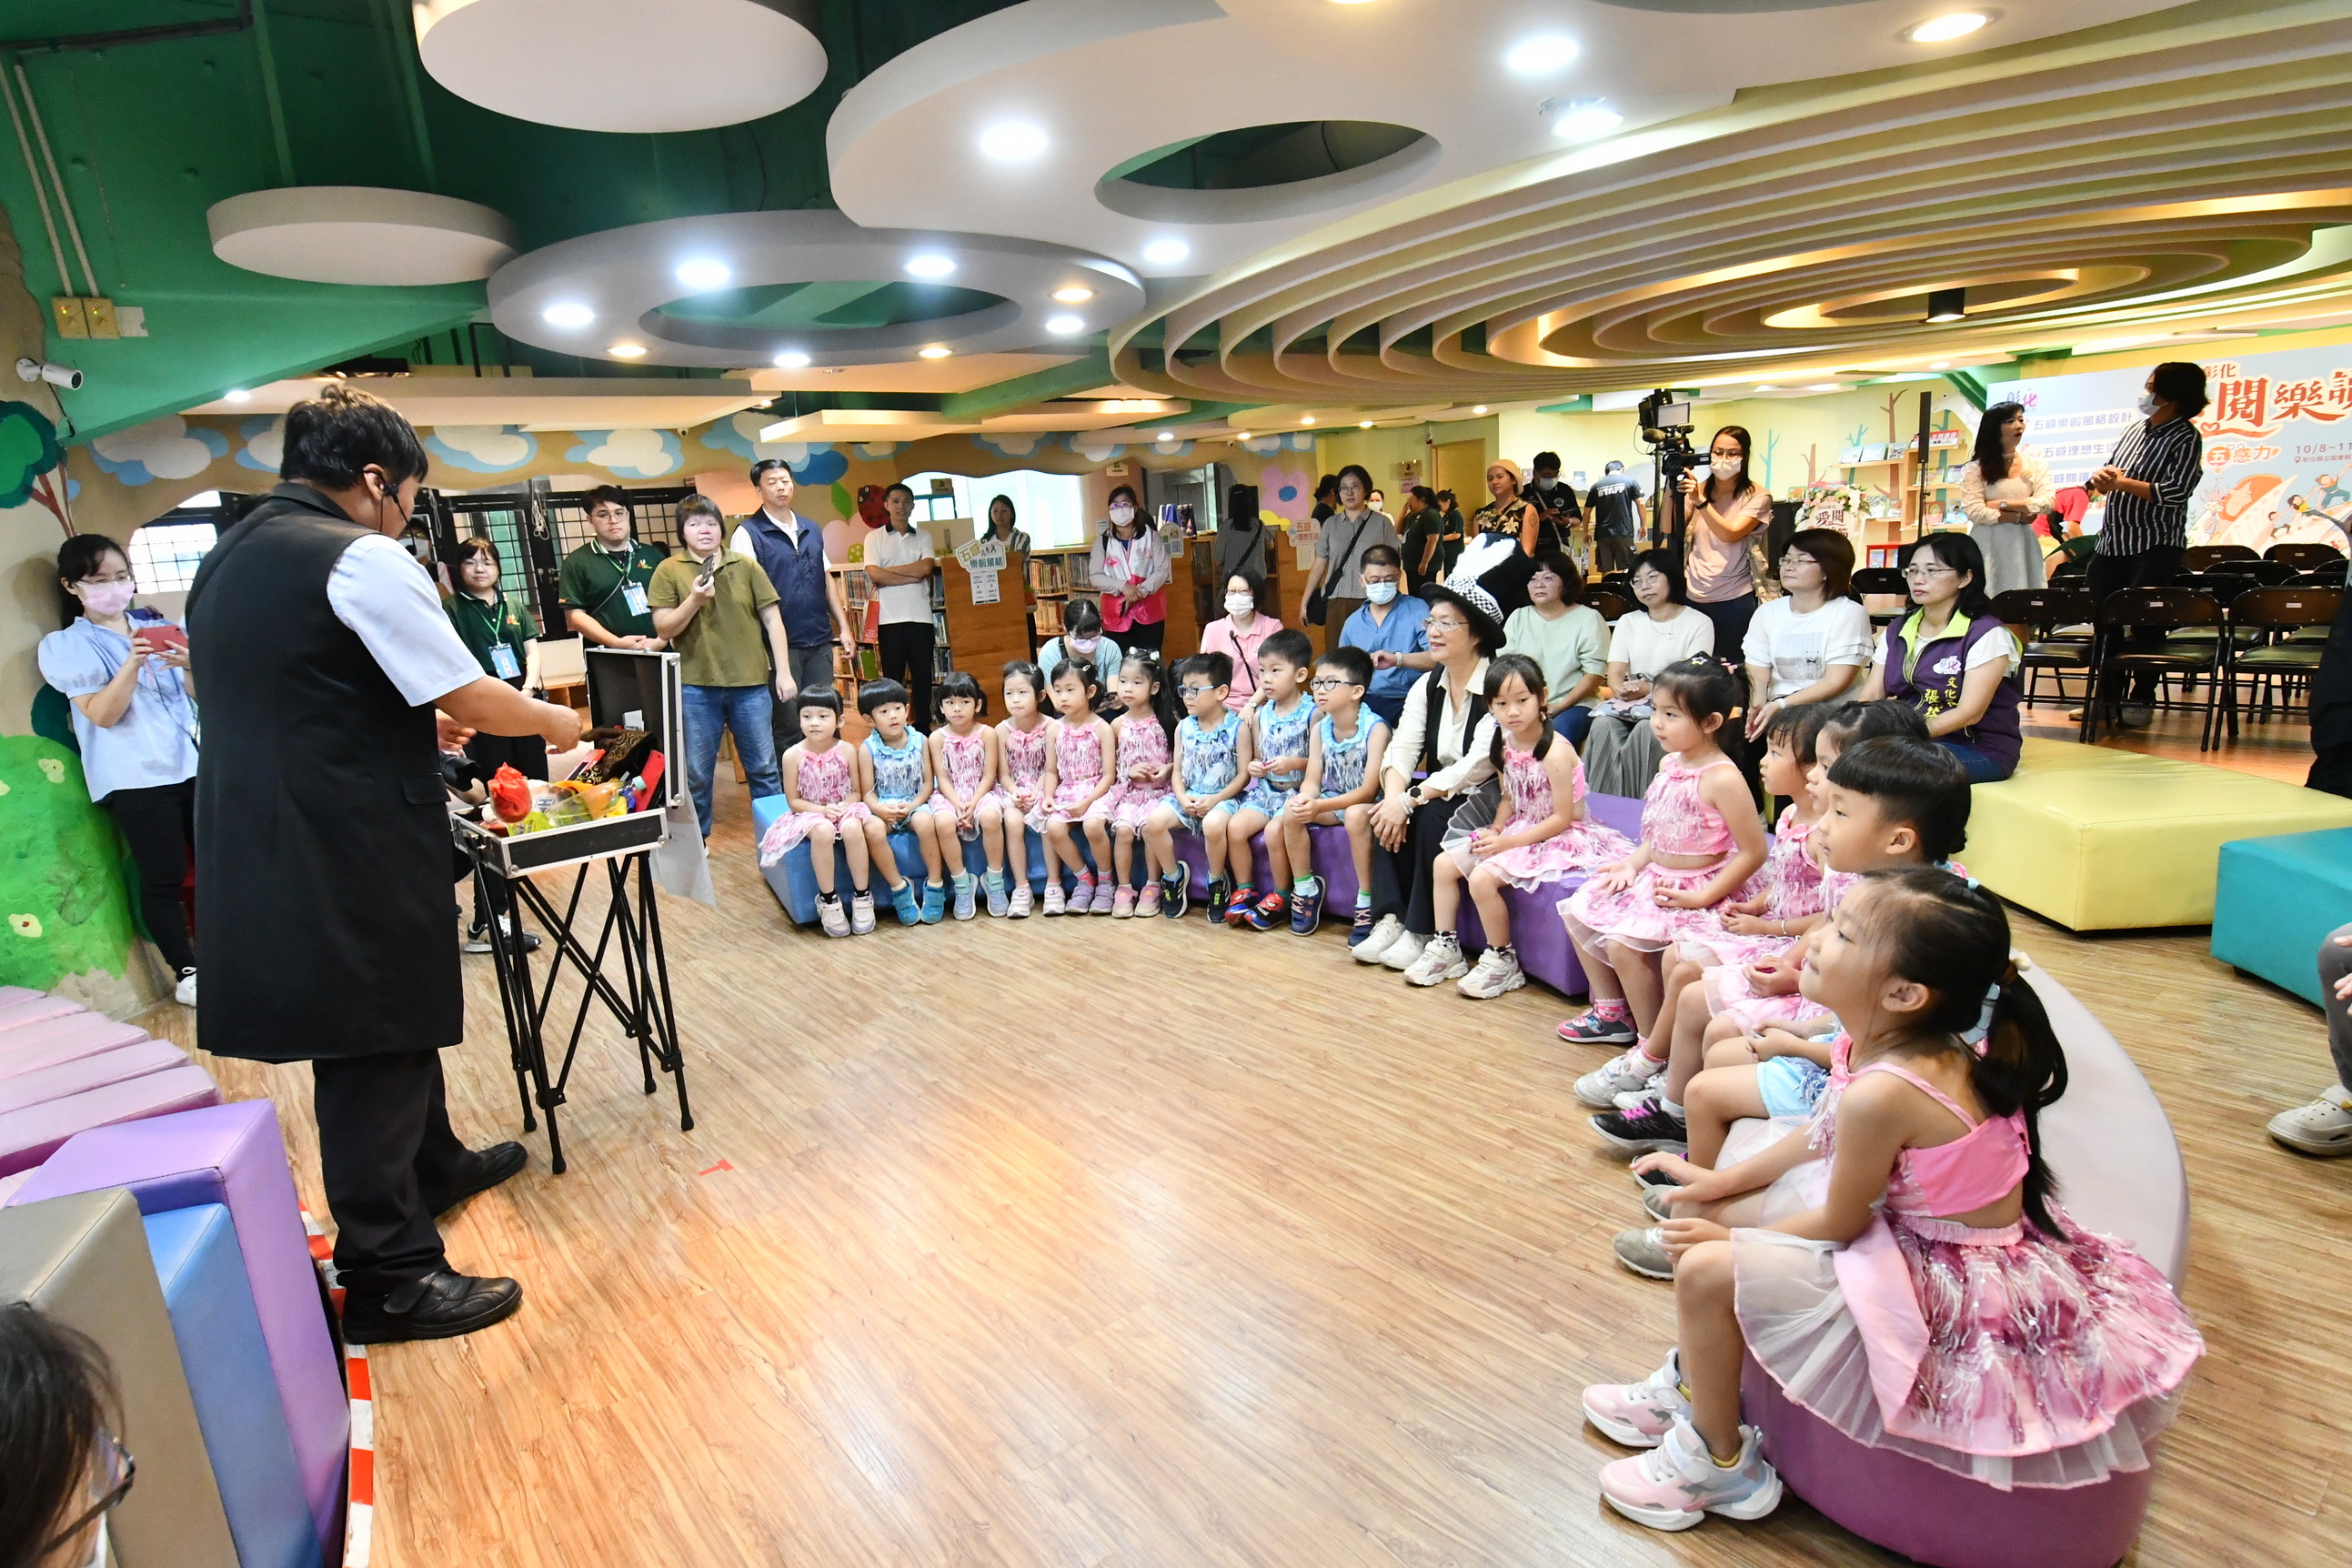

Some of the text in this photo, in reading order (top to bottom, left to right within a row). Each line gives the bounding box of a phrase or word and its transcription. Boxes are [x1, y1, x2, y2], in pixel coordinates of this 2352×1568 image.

[2190, 371, 2352, 427] 閱樂
[2211, 445, 2271, 463] 五感力
